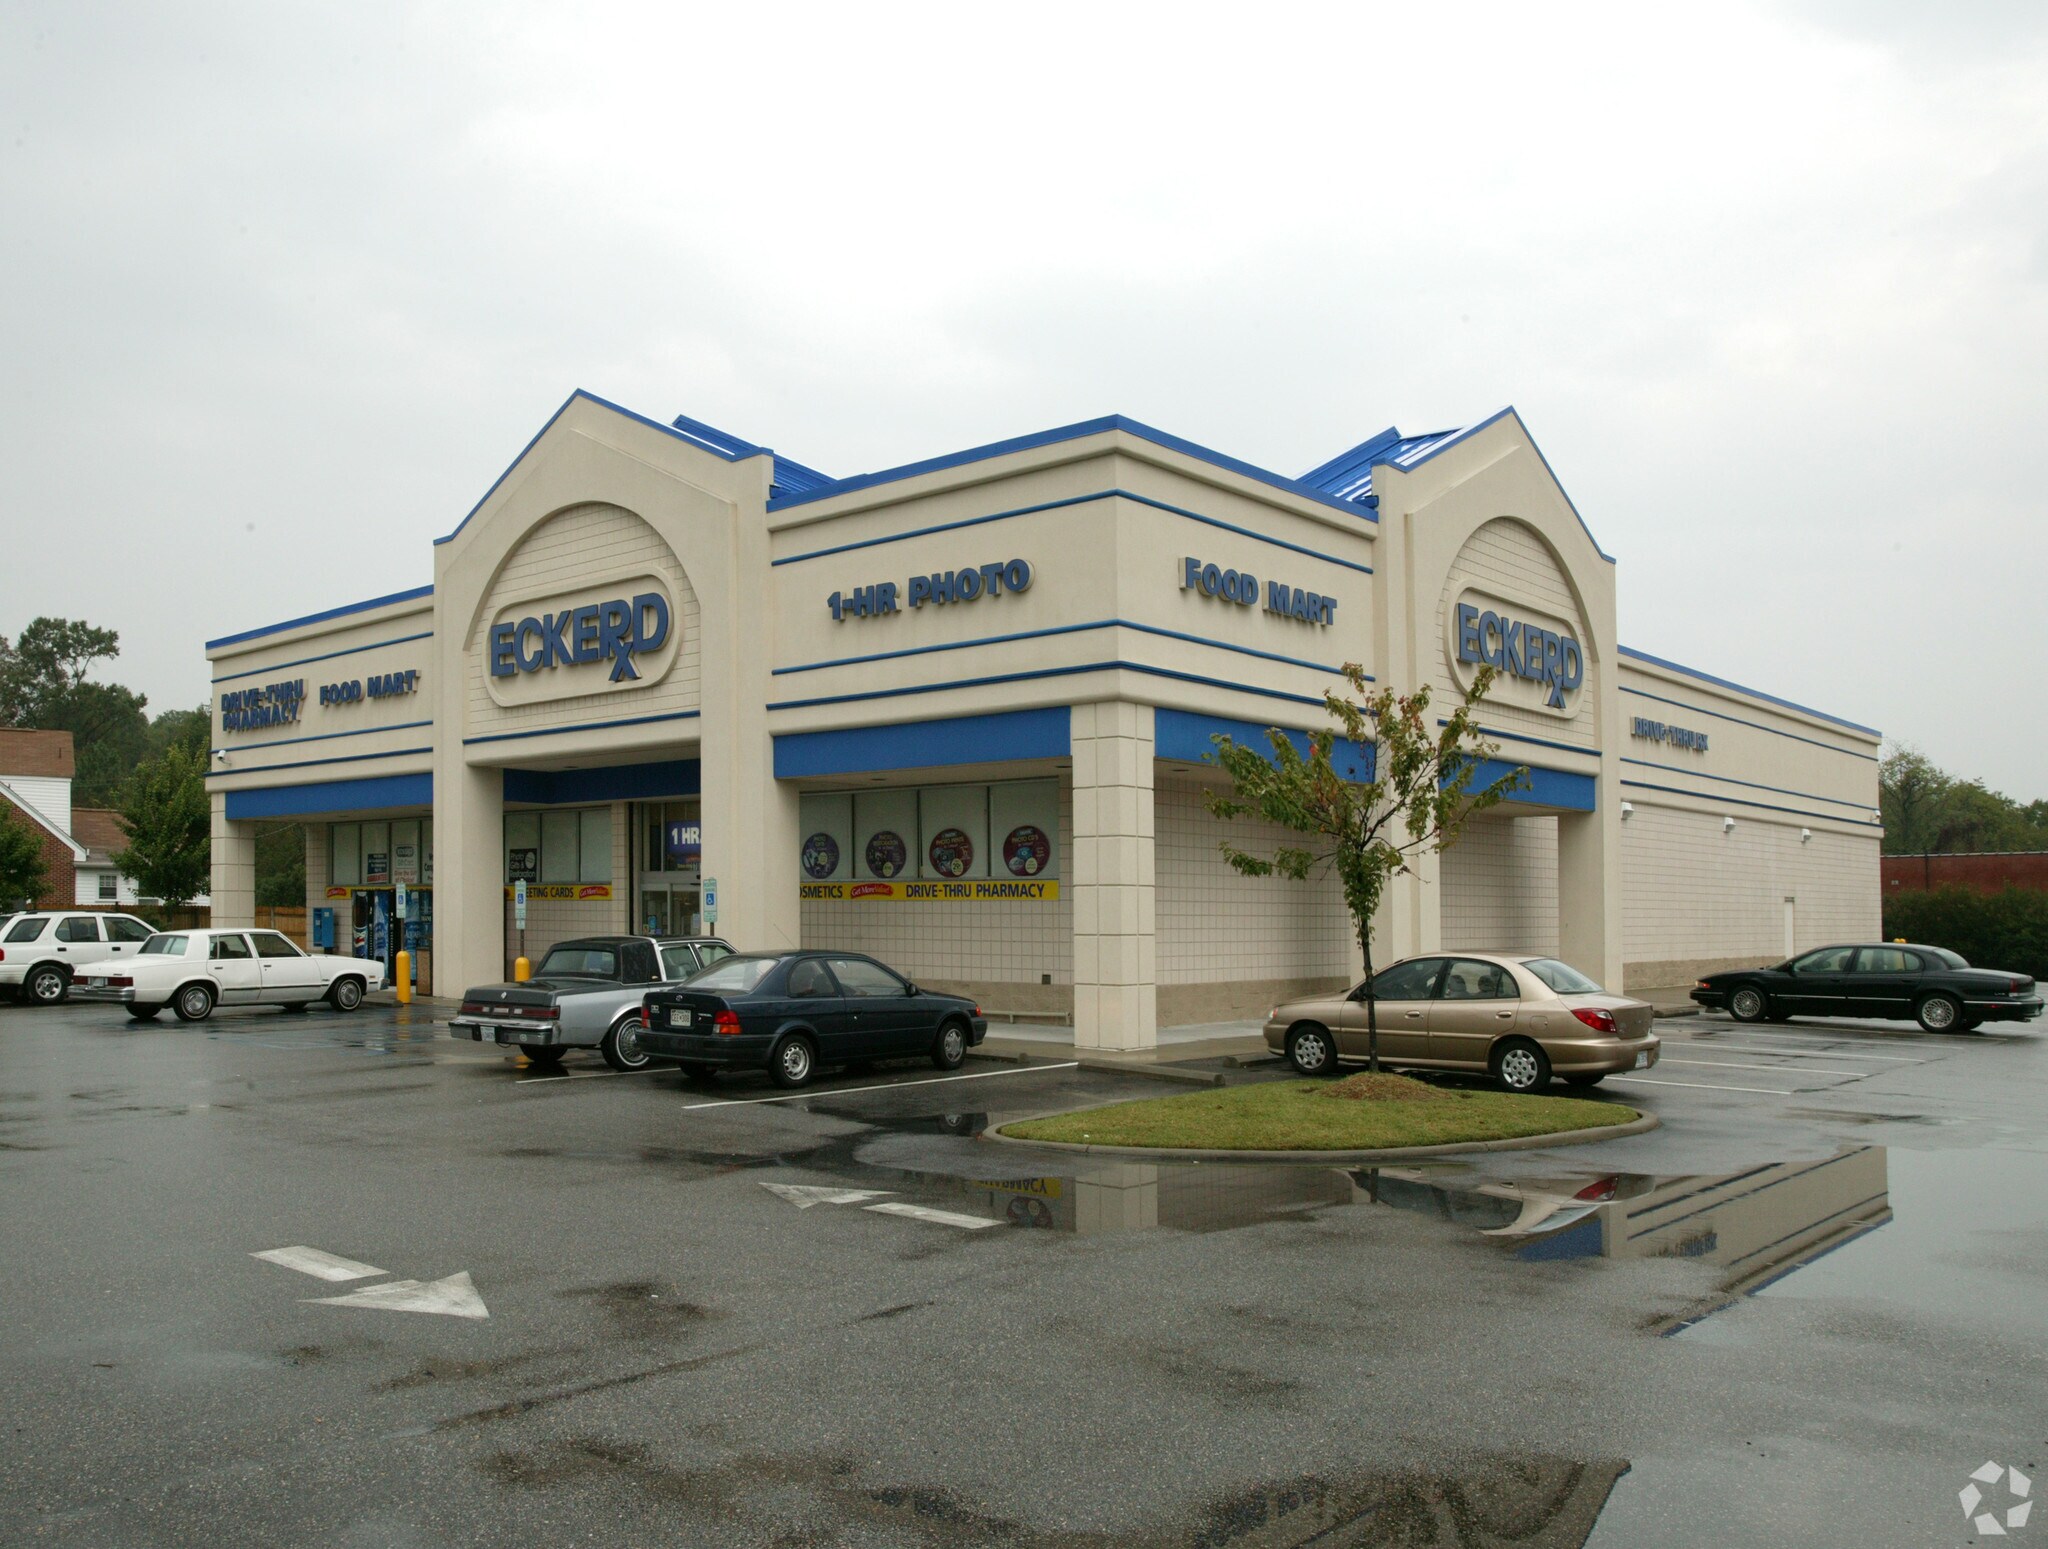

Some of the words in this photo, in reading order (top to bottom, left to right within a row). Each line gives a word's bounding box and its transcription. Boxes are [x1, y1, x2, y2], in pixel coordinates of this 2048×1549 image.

[827, 582, 898, 621] 1-HR
[908, 558, 1031, 608] PHOTO
[1183, 556, 1259, 605] FOOD
[1267, 581, 1338, 626] MART
[491, 592, 670, 677] ECKERD
[1458, 602, 1584, 690] ECKERD
[221, 678, 304, 712] DRIVE-THRU
[319, 680, 363, 706] FOOD
[367, 669, 417, 698] MART
[222, 700, 300, 732] PHARMACY
[1634, 716, 1695, 749] DRIVE-THRU
[671, 827, 679, 845] 1
[526, 886, 548, 898] EETING
[549, 886, 574, 898] CARDS
[799, 885, 843, 899] SMETICS
[906, 884, 972, 898] DRIVE-THRU
[976, 883, 1045, 898] PHARMACY
